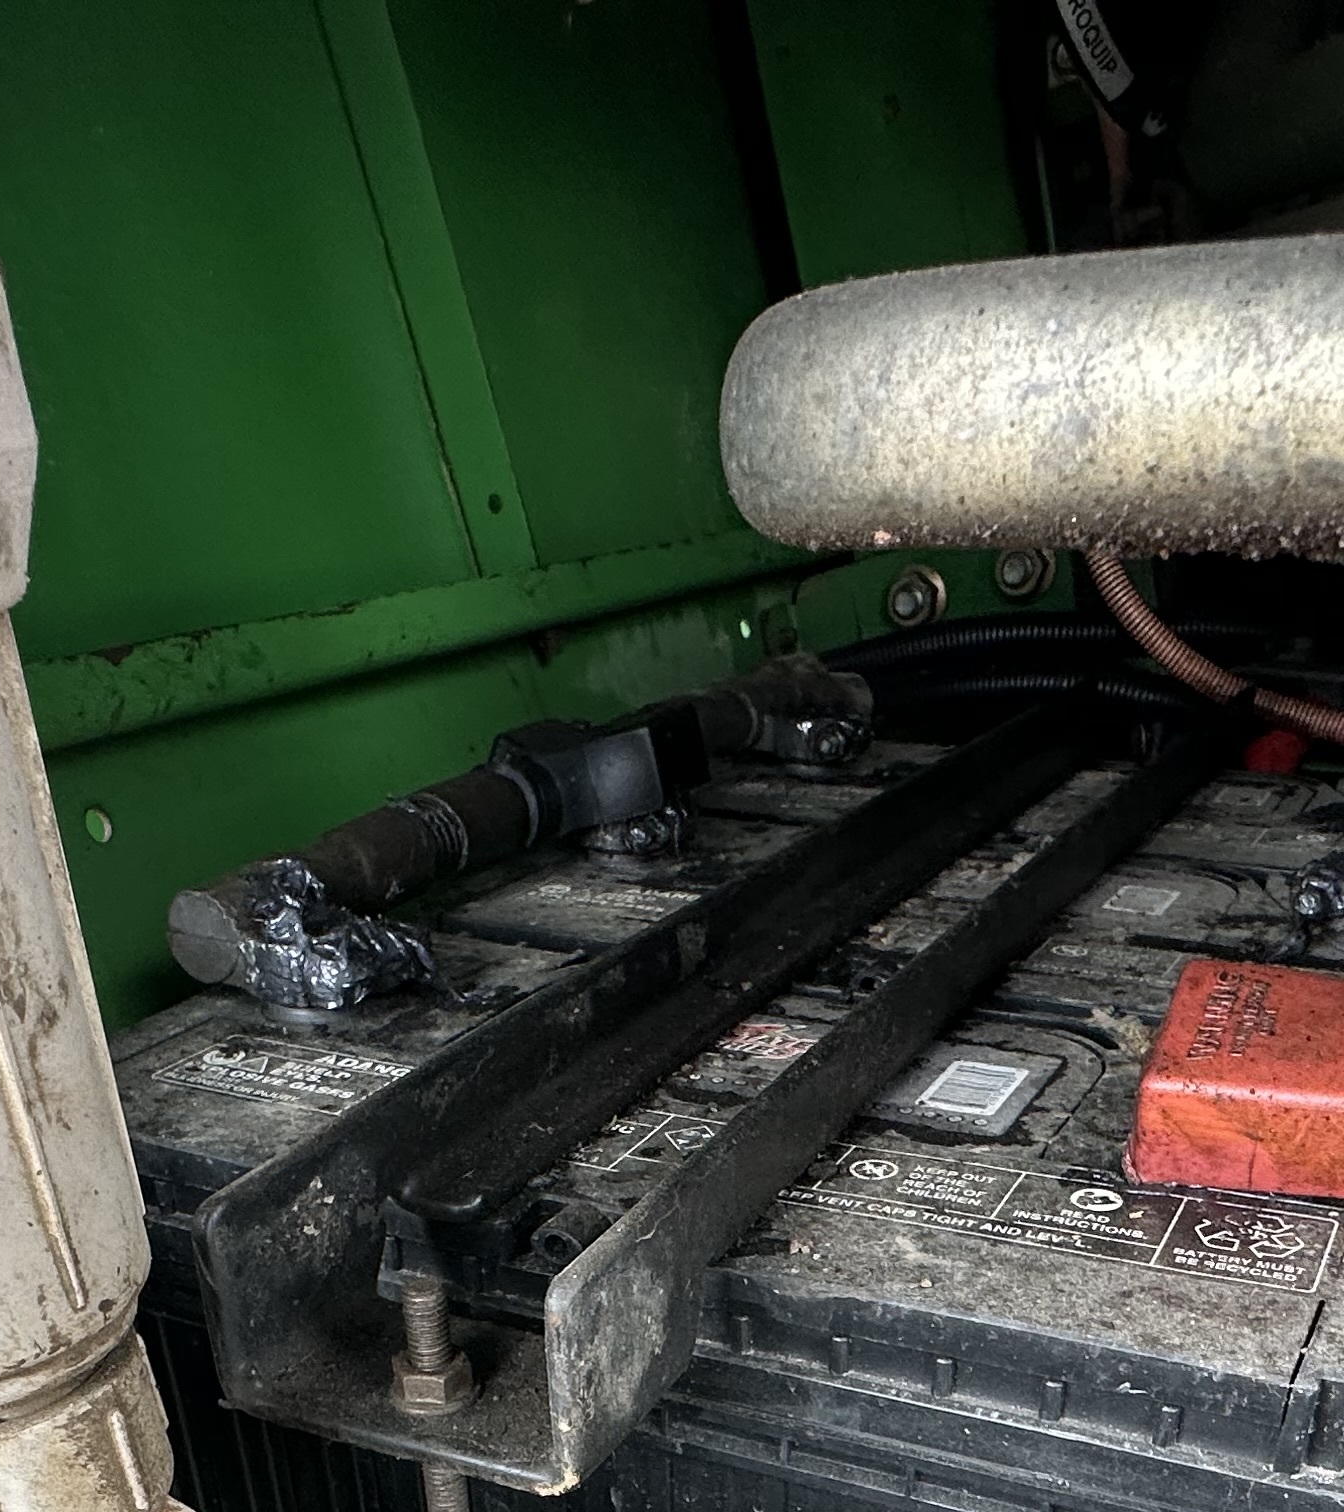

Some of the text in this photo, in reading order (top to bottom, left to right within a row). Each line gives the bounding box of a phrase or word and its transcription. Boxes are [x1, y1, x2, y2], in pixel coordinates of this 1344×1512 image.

[1067, 0, 1118, 75] ROQUIP
[336, 1058, 412, 1077] DANG
[909, 1172, 933, 1181] OF
[914, 1164, 997, 1184] KEEP OUT
[902, 1179, 988, 1198] REACH OF
[778, 1189, 1092, 1248] EEP VENT CAPS TIGHT AND LEVL.
[1060, 1209, 1111, 1224] READ
[1173, 1247, 1306, 1275] BATTERY MUST
[1174, 1255, 1297, 1282] BE RECYCLED
